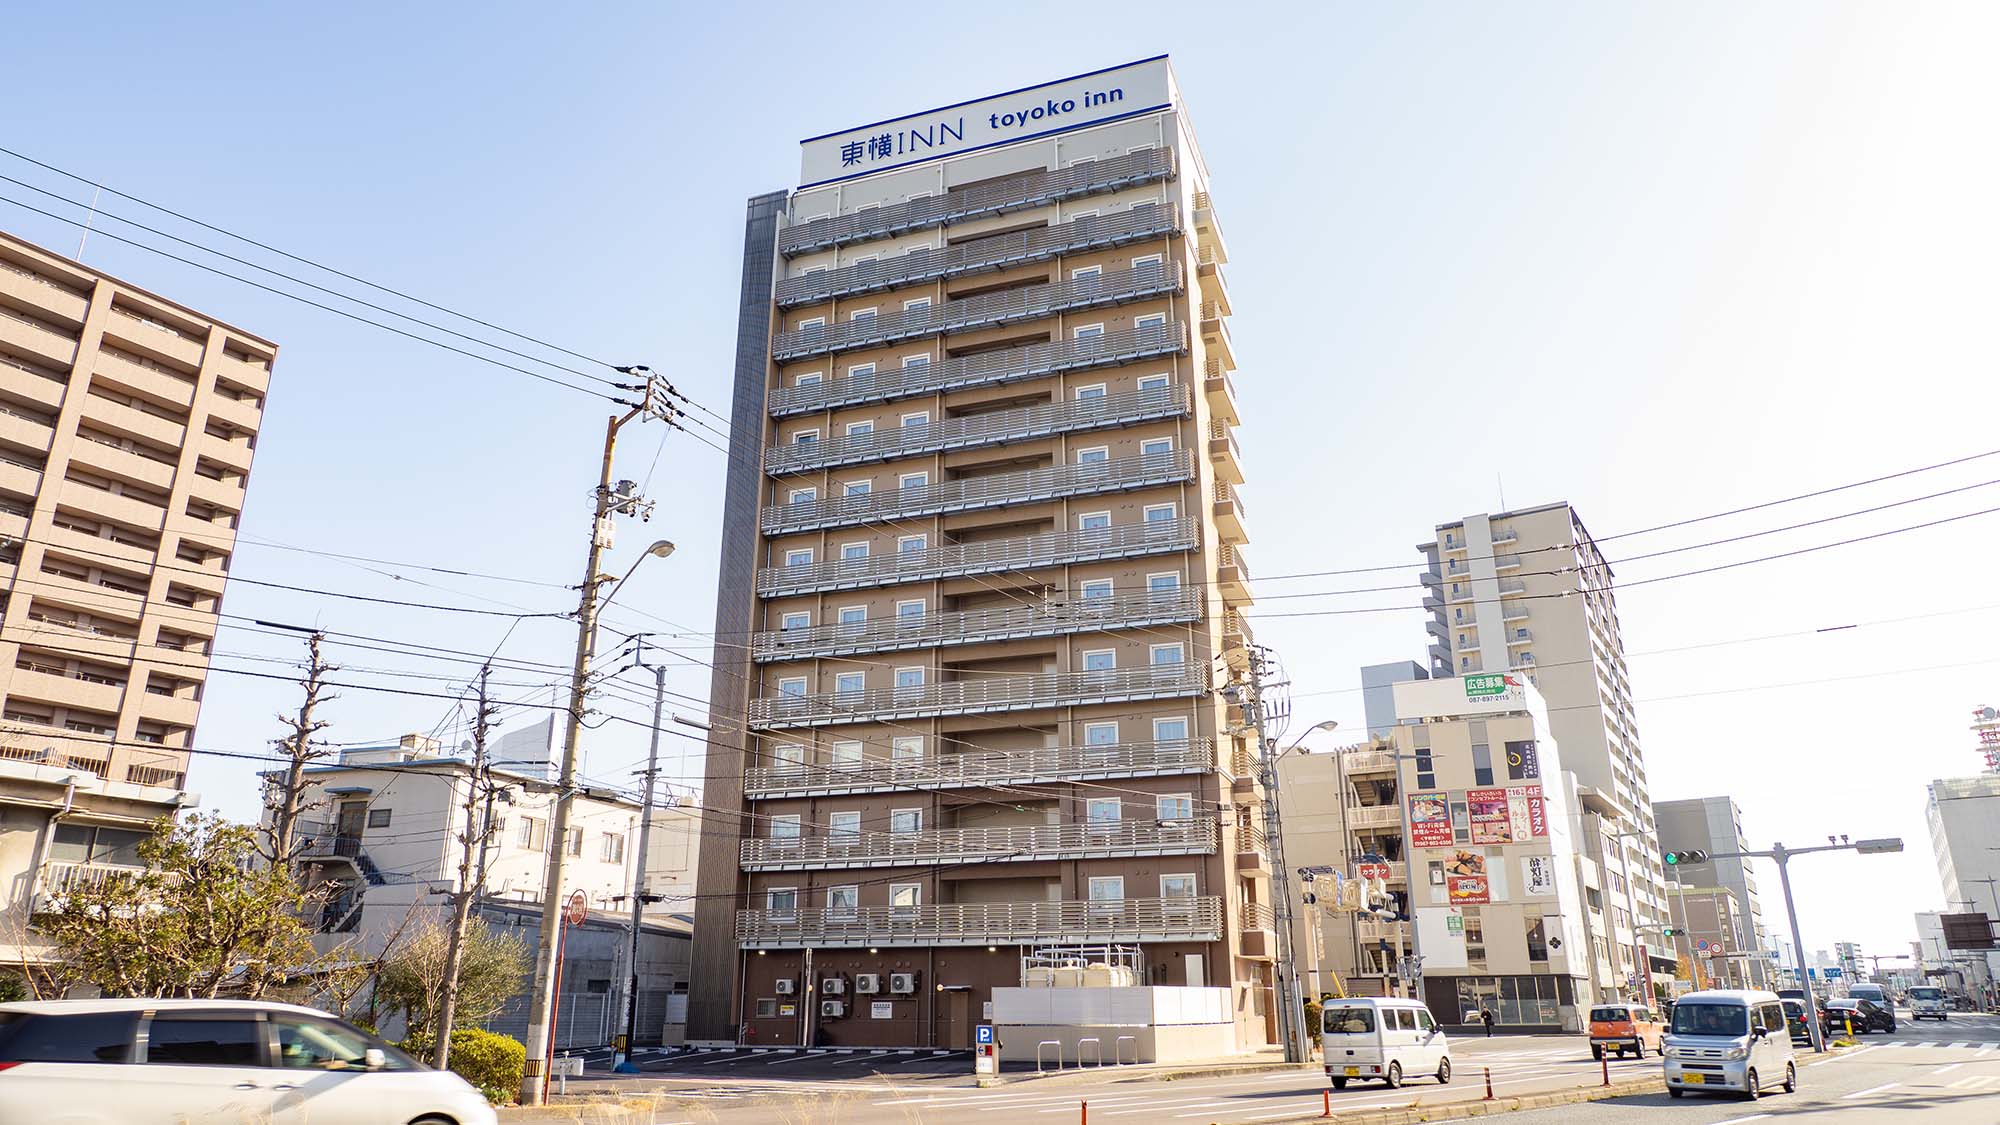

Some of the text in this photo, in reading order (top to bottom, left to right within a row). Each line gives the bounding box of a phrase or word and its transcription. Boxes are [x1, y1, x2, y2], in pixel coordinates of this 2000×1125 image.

[988, 86, 1124, 130] toyoko inn
[840, 116, 964, 168] 東横INN
[1467, 676, 1504, 690] 広告募集
[1527, 787, 1540, 796] 4F
[1530, 799, 1545, 834] カラオケ
[980, 1028, 990, 1042] P
